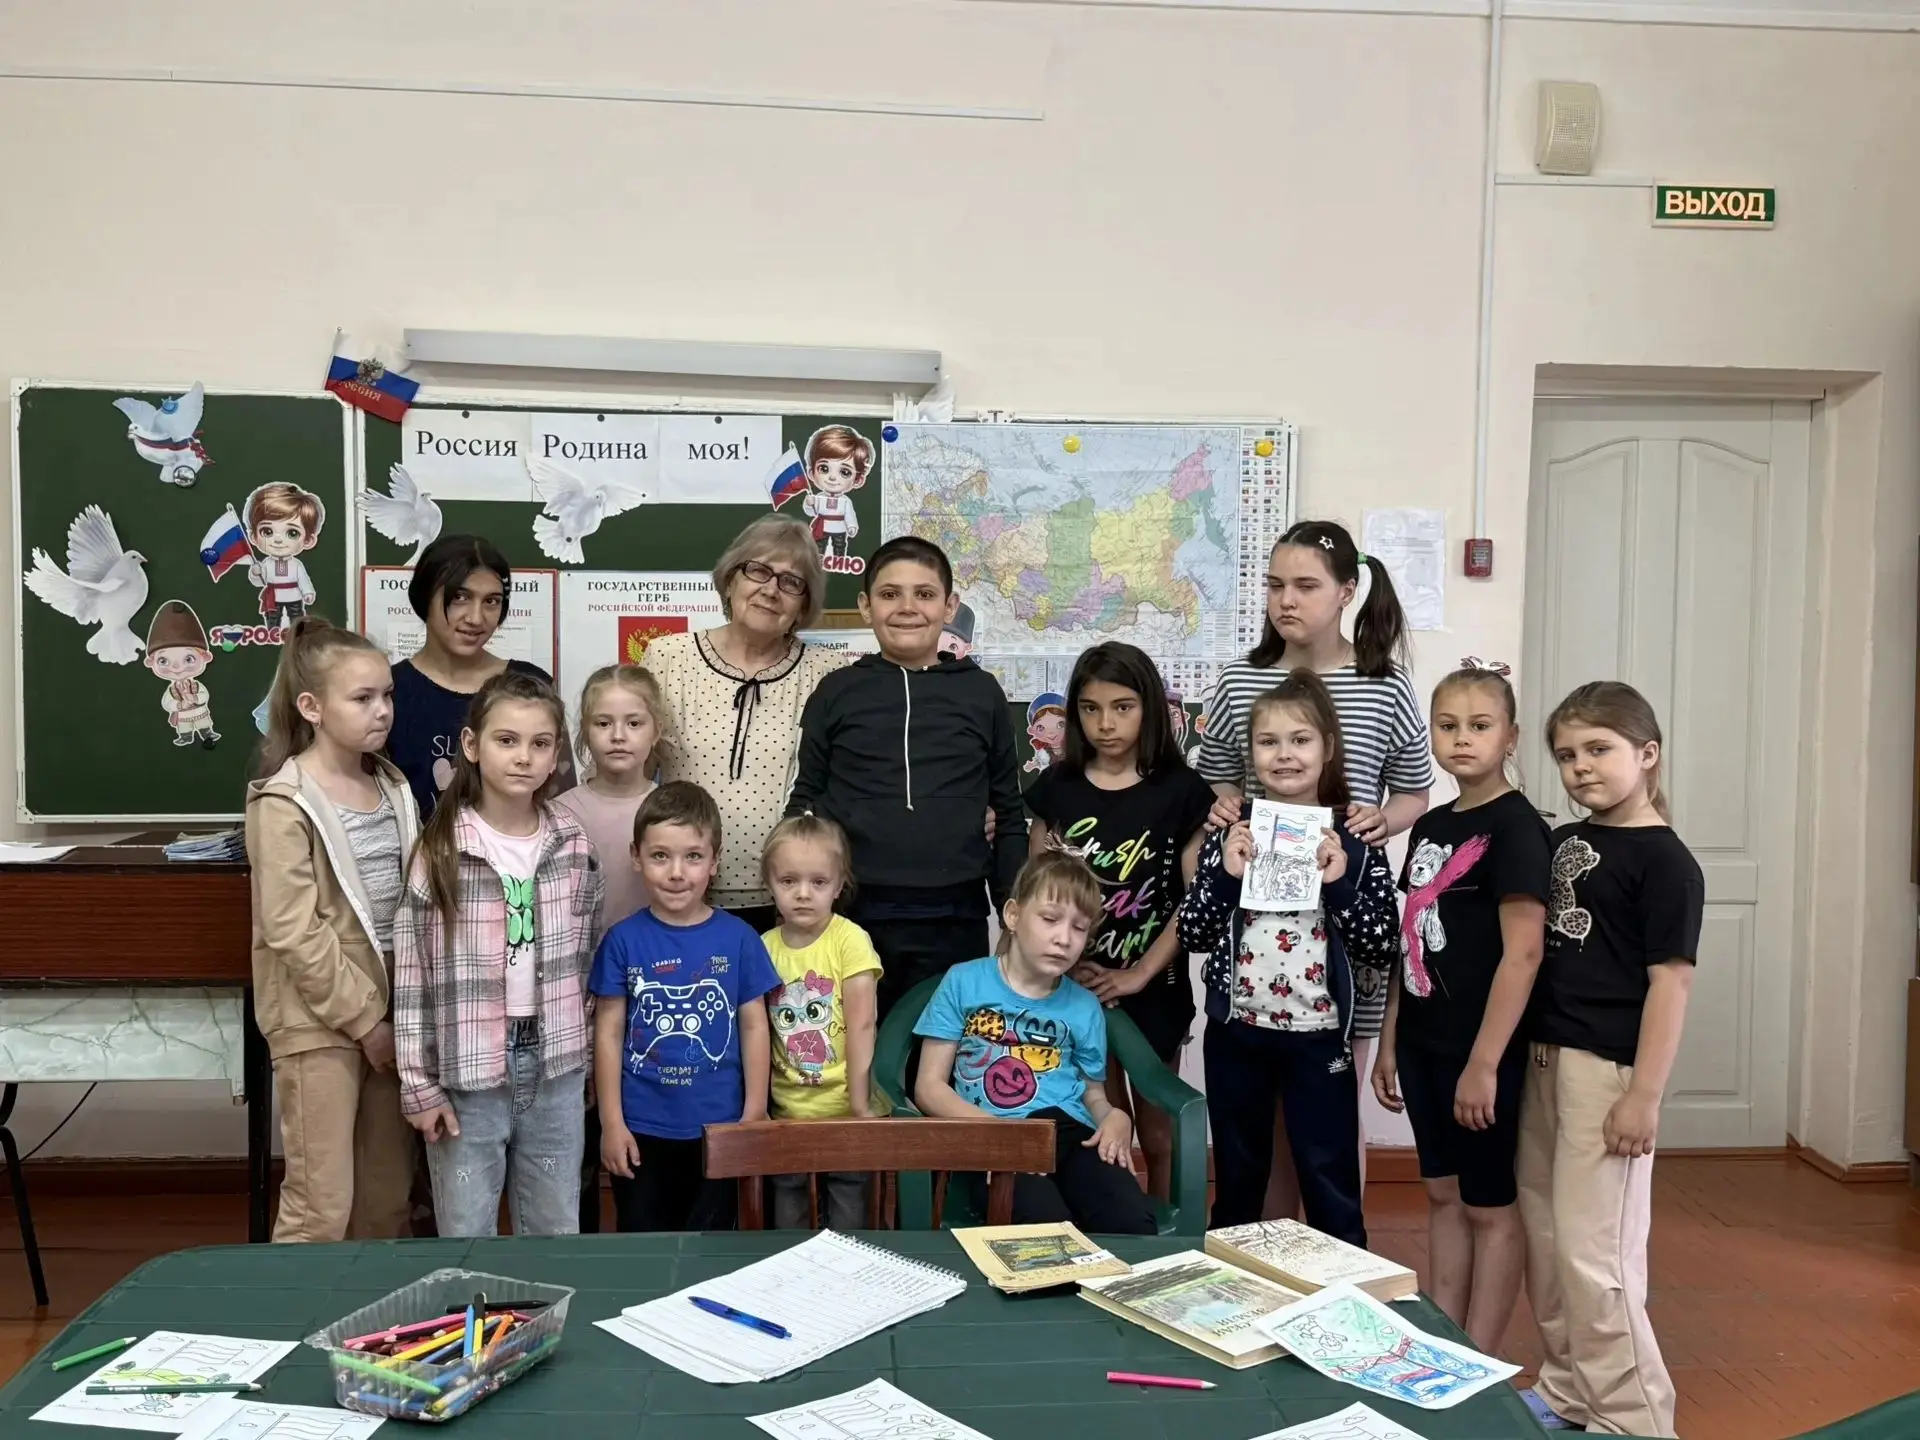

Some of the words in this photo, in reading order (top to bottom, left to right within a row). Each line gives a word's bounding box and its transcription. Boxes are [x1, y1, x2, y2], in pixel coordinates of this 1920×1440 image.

[1664, 190, 1766, 220] ВЫХОД
[338, 380, 382, 402] ОССИЯ
[415, 430, 518, 456] Россия
[543, 434, 648, 461] Родина
[688, 436, 749, 461] моя!
[638, 593, 670, 602] ГЕРБ
[588, 603, 654, 612] РОССИЙСКОЙ
[657, 604, 719, 613] ФЕДЕРАЦИИ
[651, 957, 682, 968] LOADING
[711, 963, 731, 974] START
